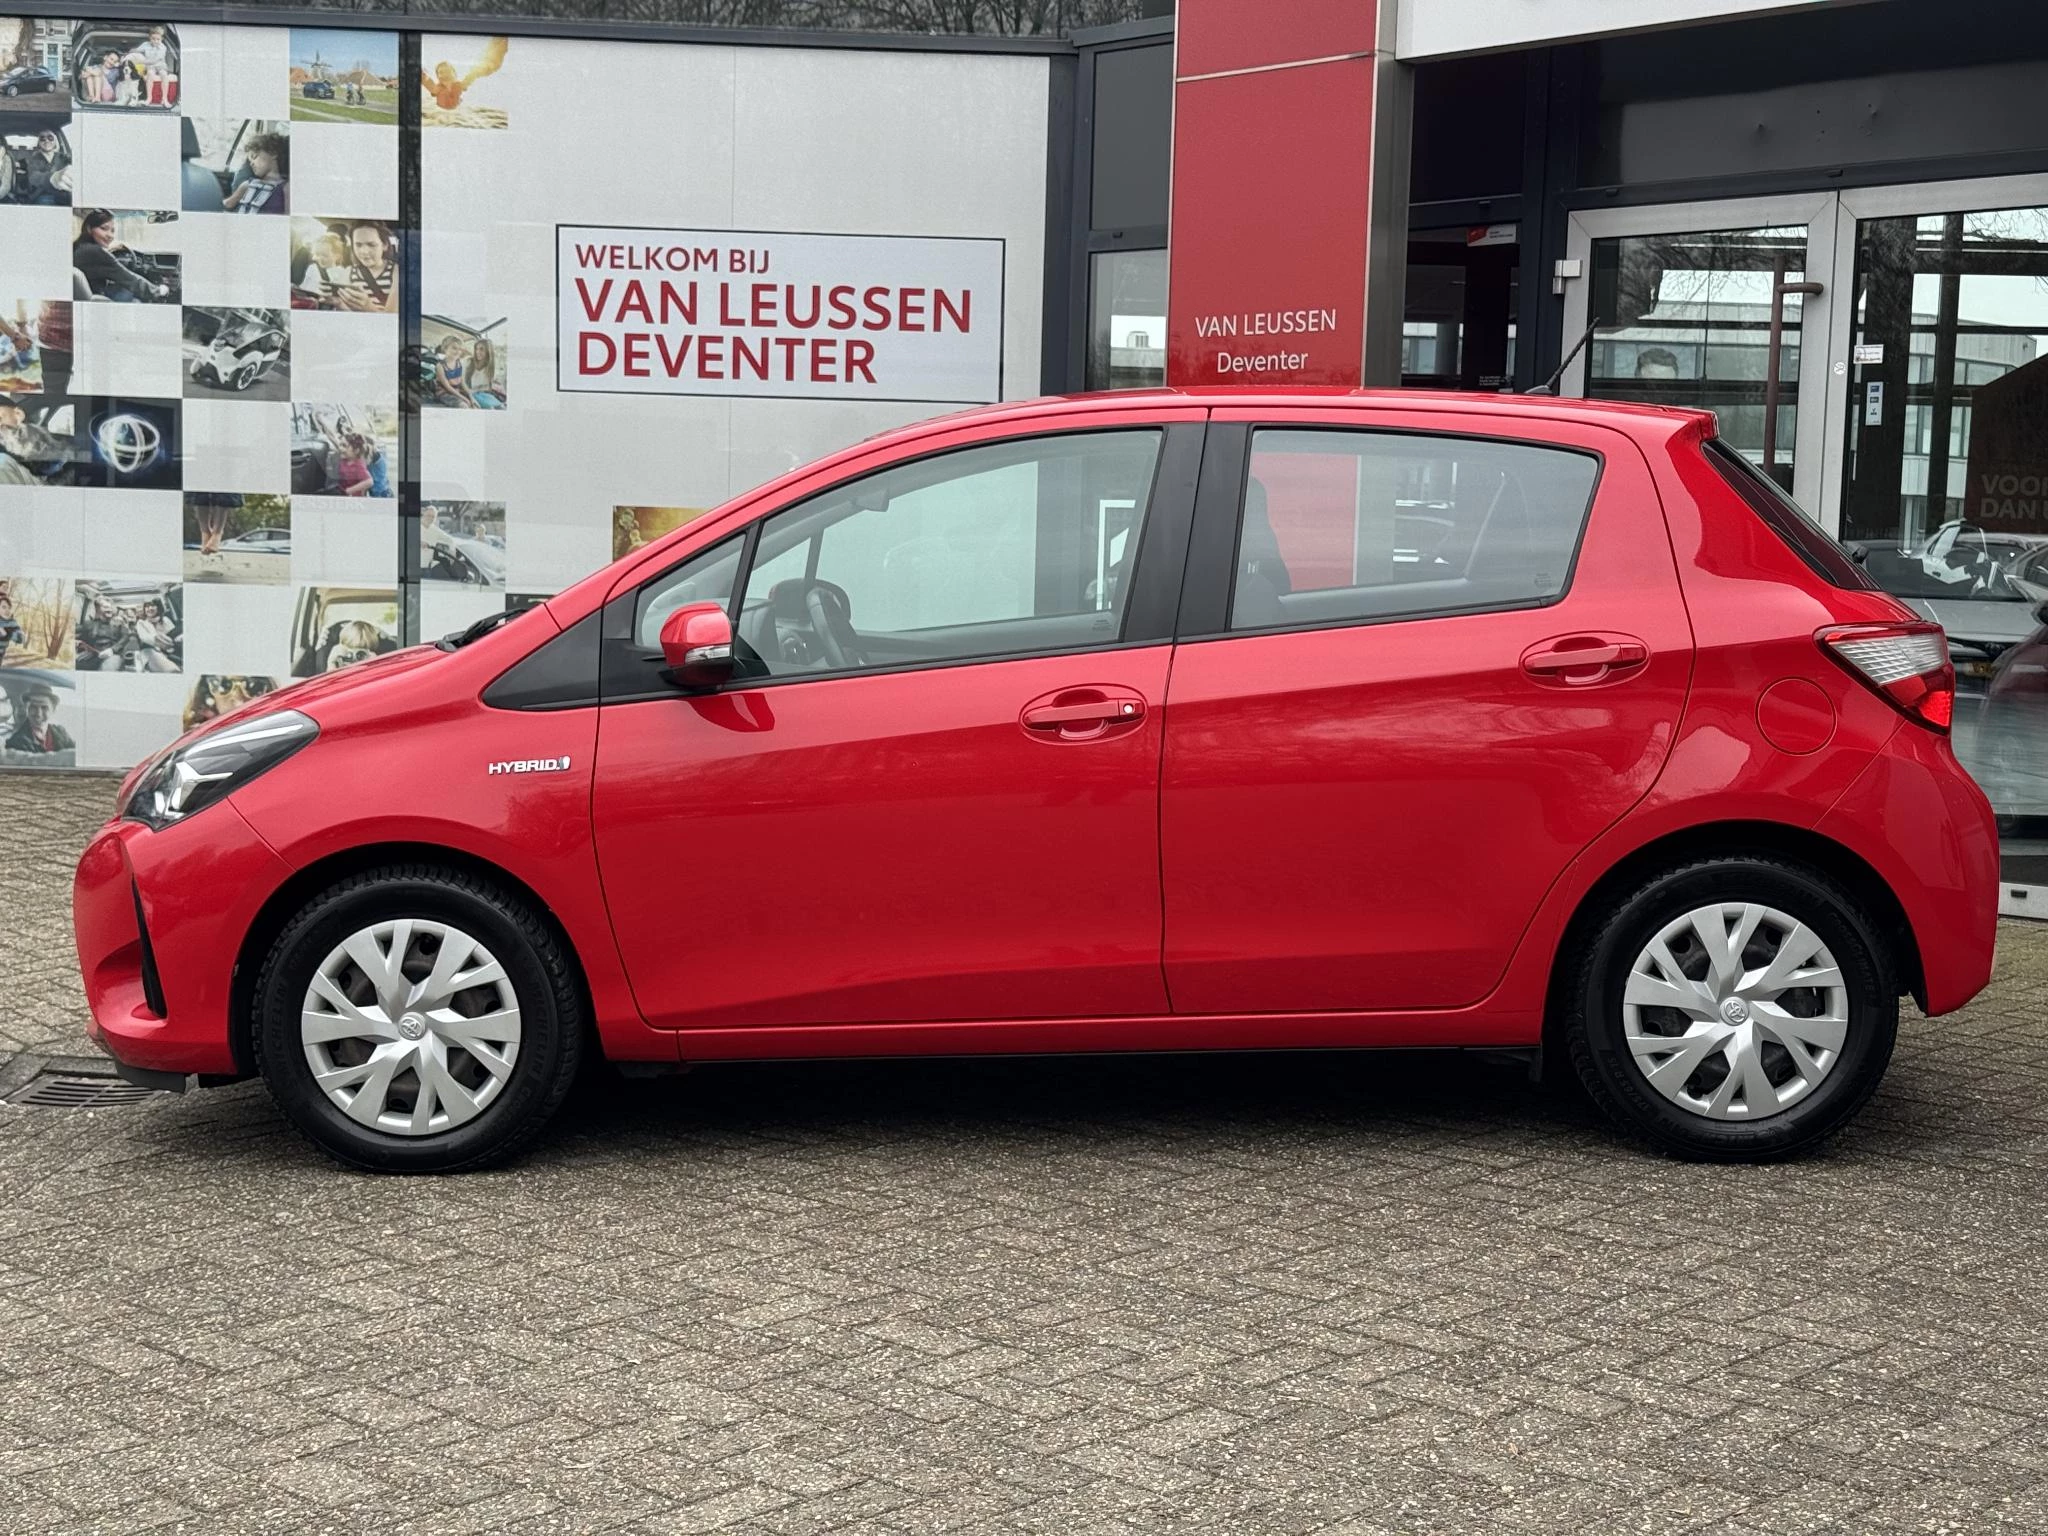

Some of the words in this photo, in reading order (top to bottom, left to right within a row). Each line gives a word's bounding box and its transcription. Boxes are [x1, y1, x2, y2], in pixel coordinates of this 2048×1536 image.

[575, 244, 719, 273] WELKOM
[729, 248, 770, 274] BIJ
[575, 277, 699, 326] VAN
[719, 283, 972, 334] LEUSSEN
[1195, 314, 1237, 338] VAN
[1243, 308, 1337, 336] LEUSSEN
[577, 331, 878, 384] DEVENTER
[1217, 350, 1309, 374] Deventer
[1980, 497, 2037, 520] DAN
[488, 758, 558, 775] HYBRID
